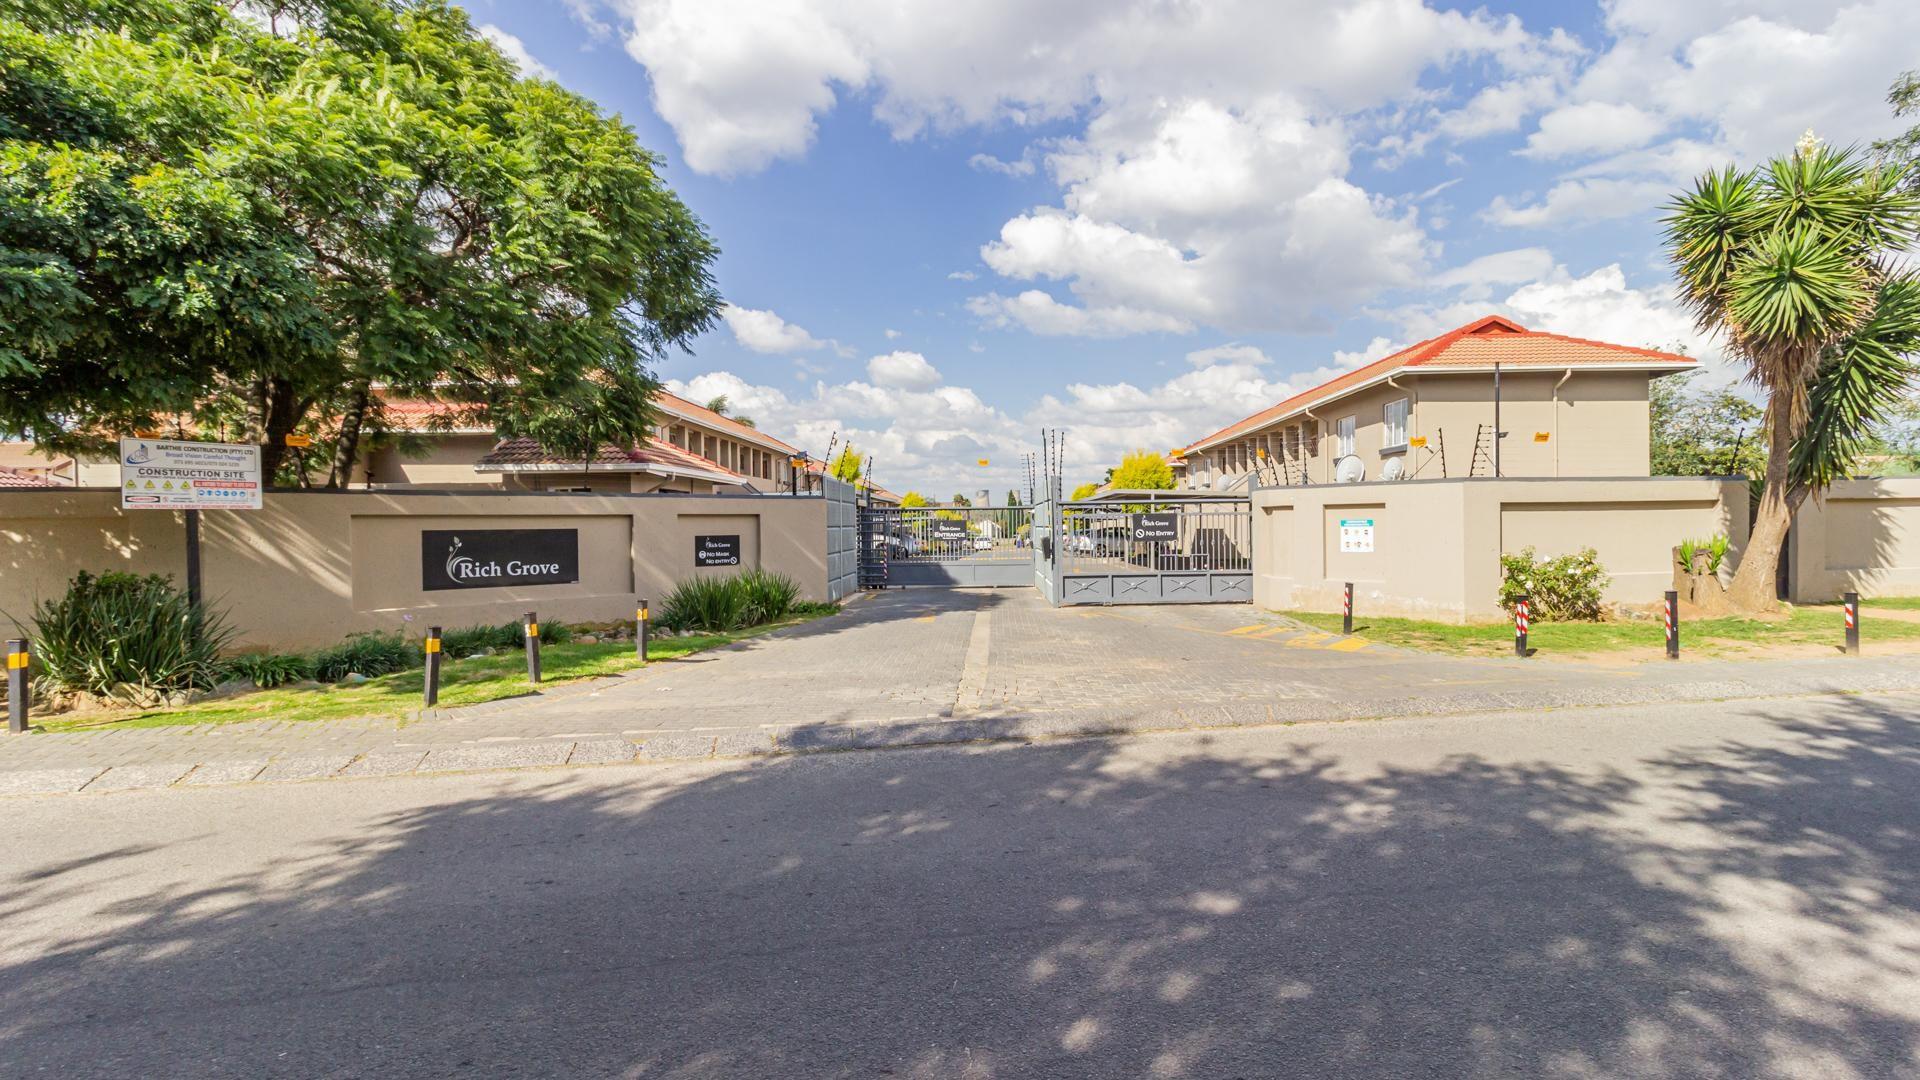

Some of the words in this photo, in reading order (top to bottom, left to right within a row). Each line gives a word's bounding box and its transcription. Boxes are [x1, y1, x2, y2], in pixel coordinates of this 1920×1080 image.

[183, 446, 228, 454] CONSTRUCTION
[138, 468, 220, 478] CONSTRUCTION
[459, 561, 502, 578] Rich
[506, 561, 560, 576] Grove
